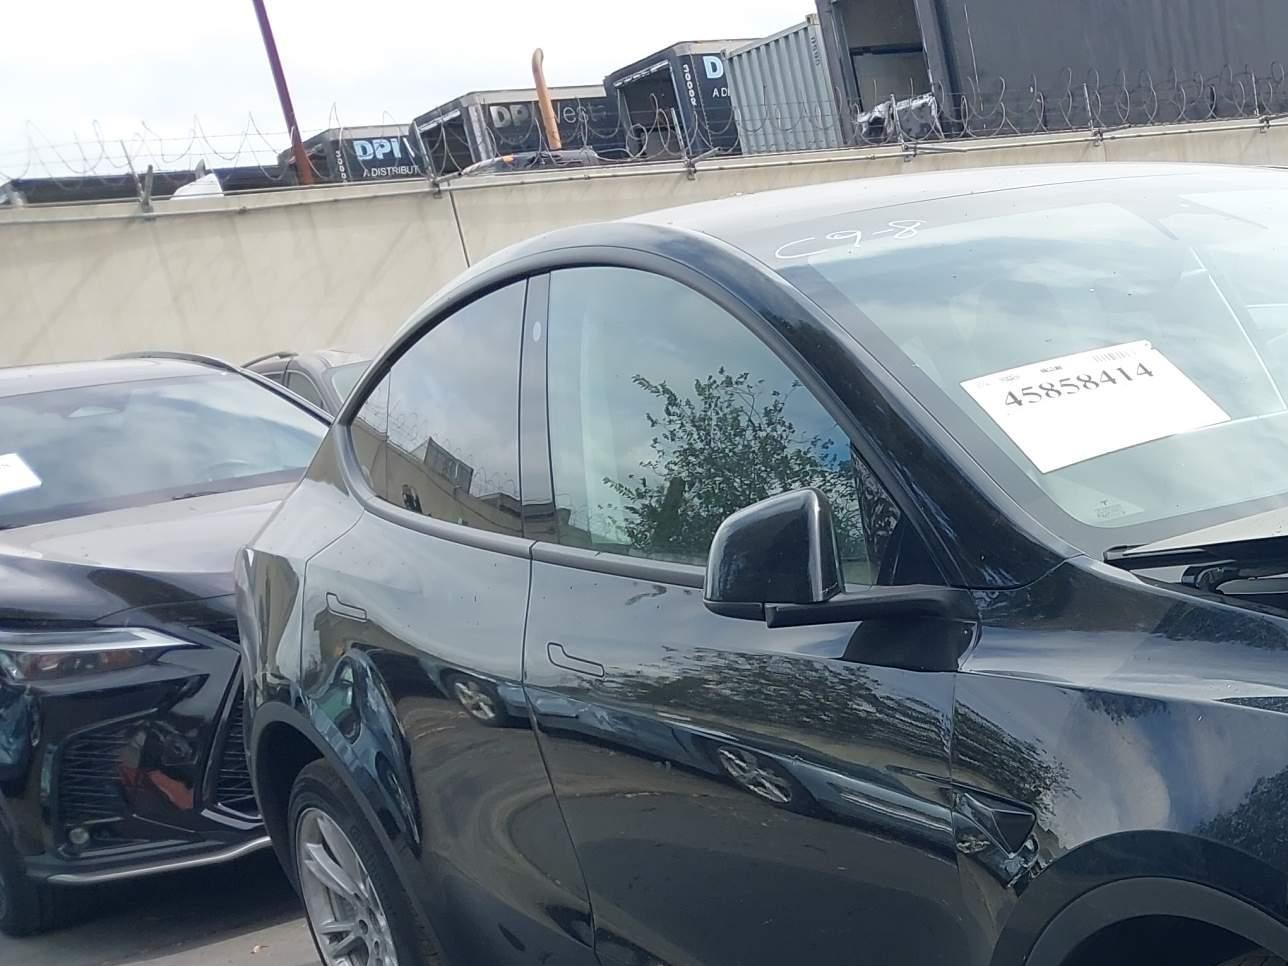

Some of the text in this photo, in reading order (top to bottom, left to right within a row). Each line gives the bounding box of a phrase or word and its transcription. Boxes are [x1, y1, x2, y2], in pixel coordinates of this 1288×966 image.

[490, 103, 532, 129] DP
[352, 137, 402, 160] DPI
[1004, 362, 1154, 407] 45858414
